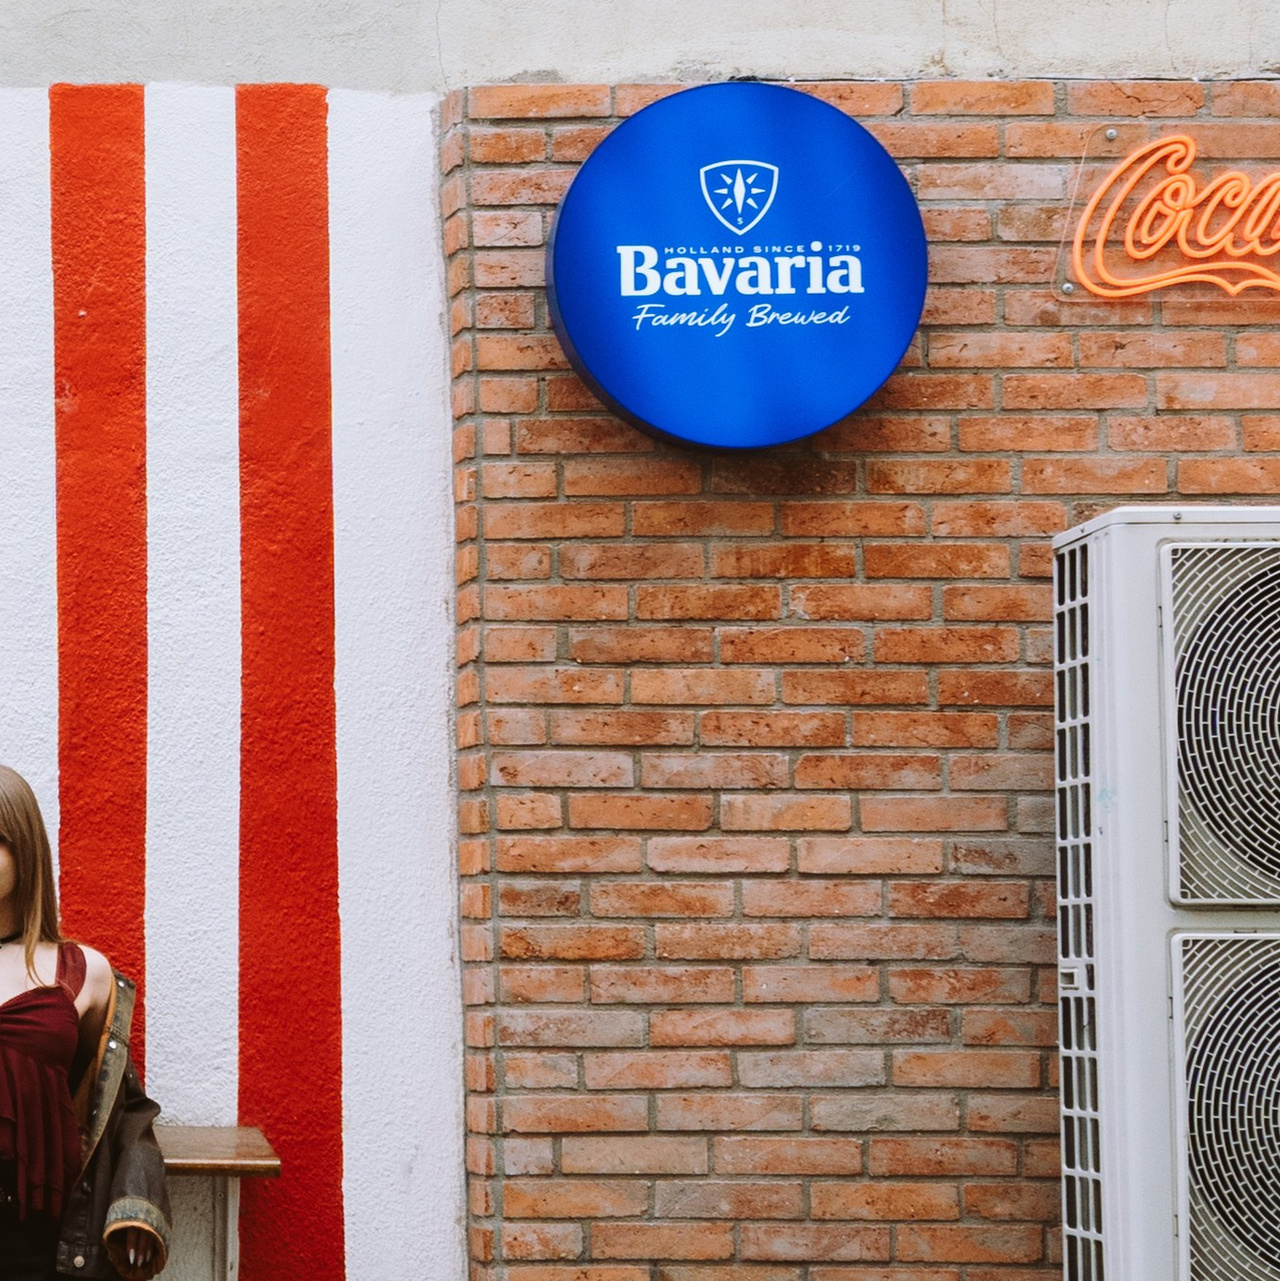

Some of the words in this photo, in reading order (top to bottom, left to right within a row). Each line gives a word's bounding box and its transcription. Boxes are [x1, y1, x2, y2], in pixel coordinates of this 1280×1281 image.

[664, 246, 744, 254] HOLLAND
[753, 245, 805, 253] SINCE
[827, 244, 861, 252] 1719
[616, 240, 865, 296] Bavaria
[632, 302, 736, 337] Family
[745, 303, 850, 328] Brewed
